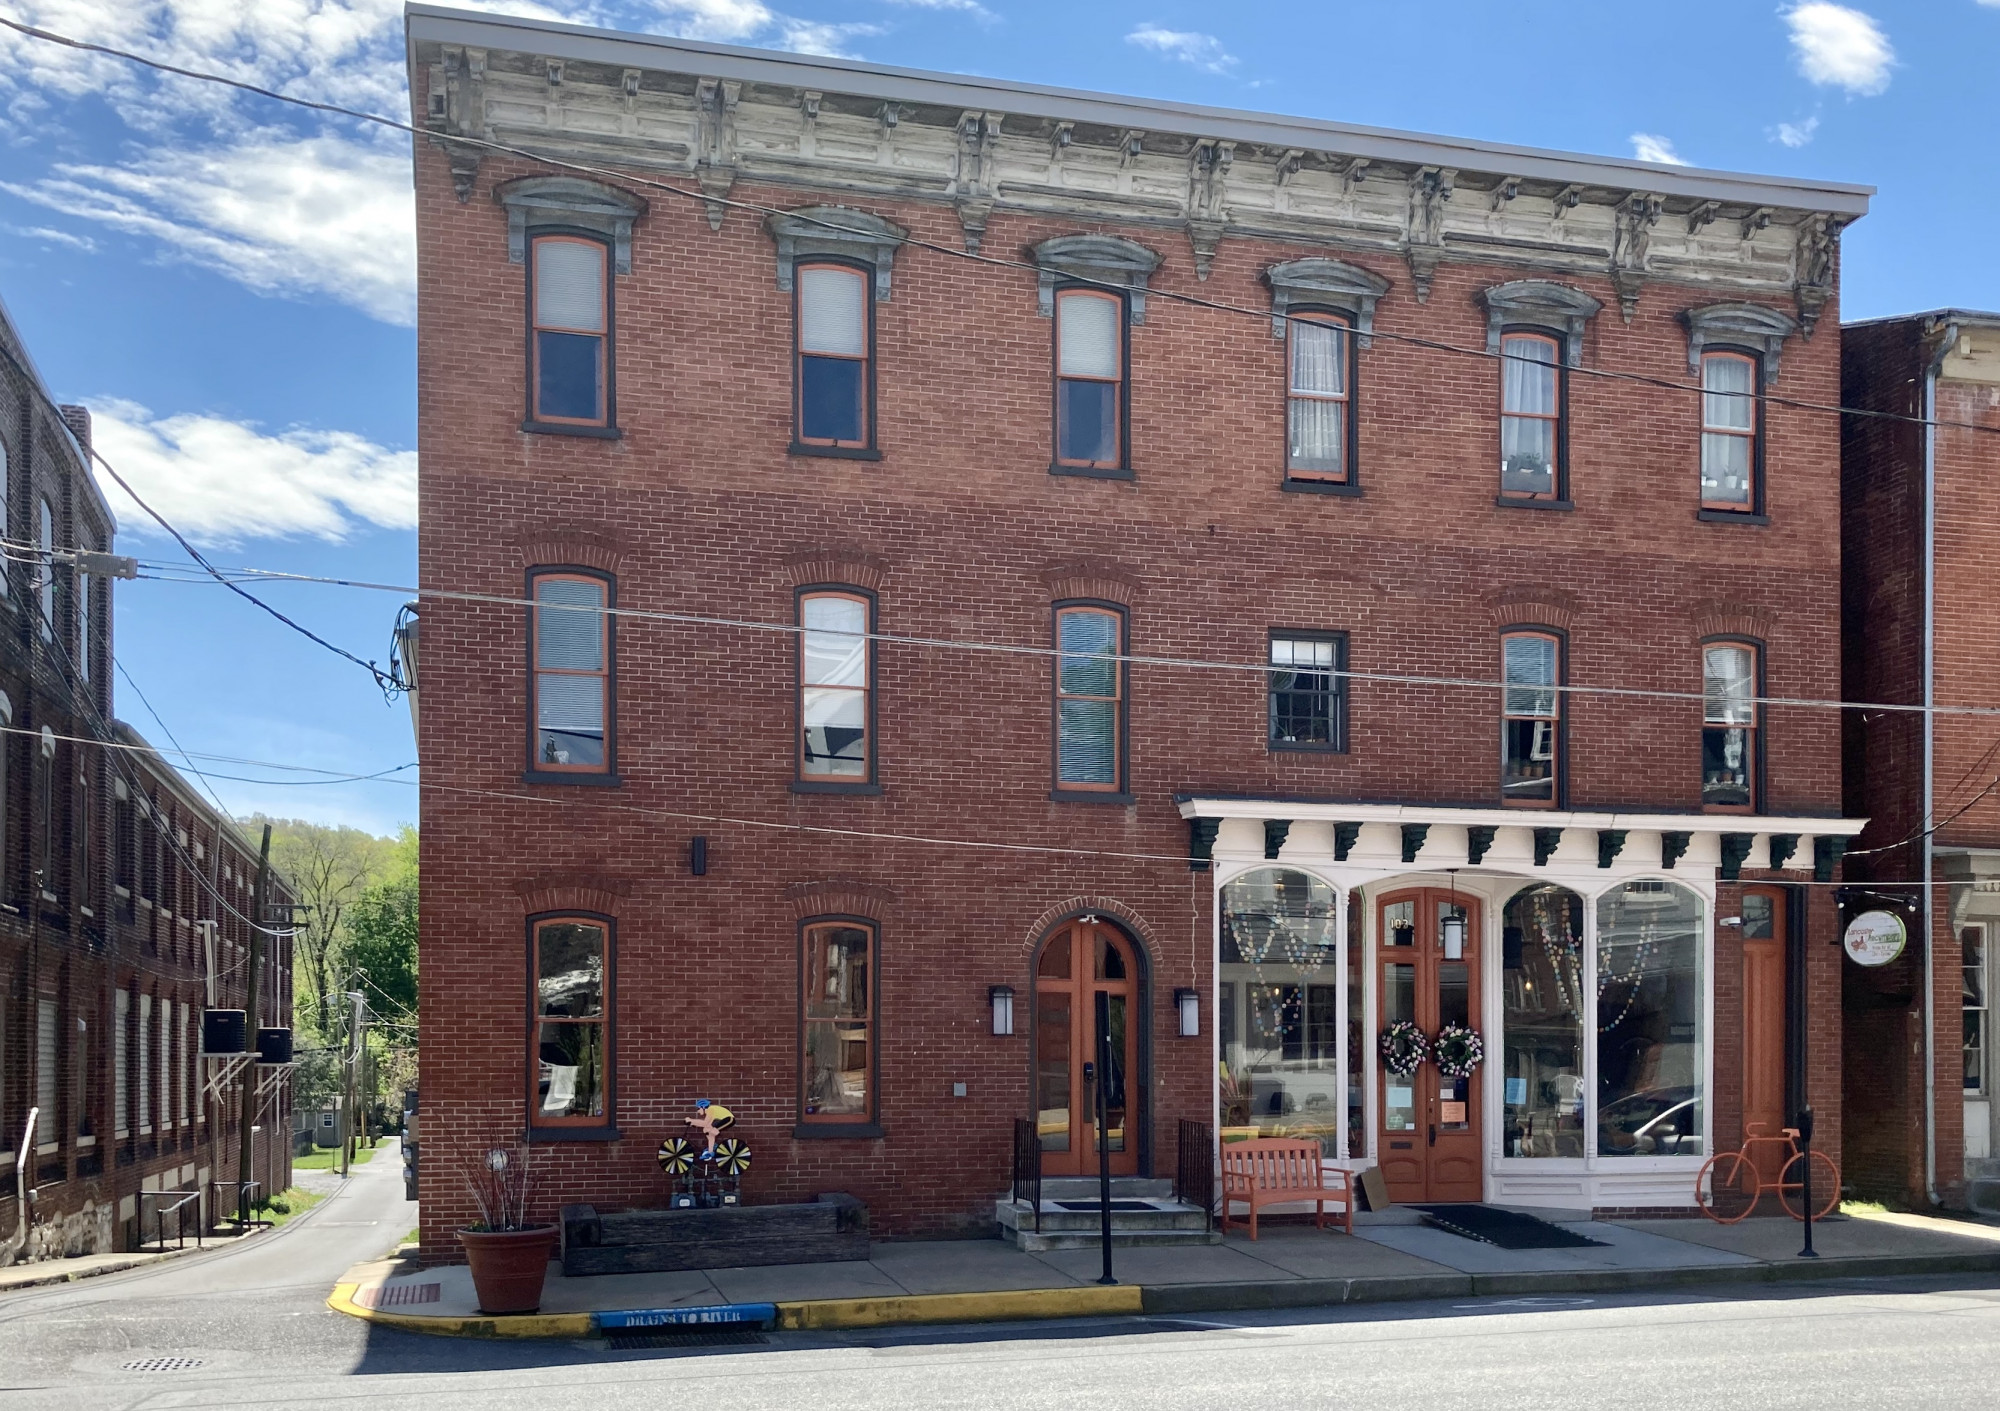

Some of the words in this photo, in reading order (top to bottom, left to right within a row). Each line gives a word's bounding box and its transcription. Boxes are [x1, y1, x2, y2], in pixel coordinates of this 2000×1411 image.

[626, 1314, 676, 1327] DRAINS
[679, 1313, 698, 1324] TO
[700, 1311, 741, 1323] RIVER
